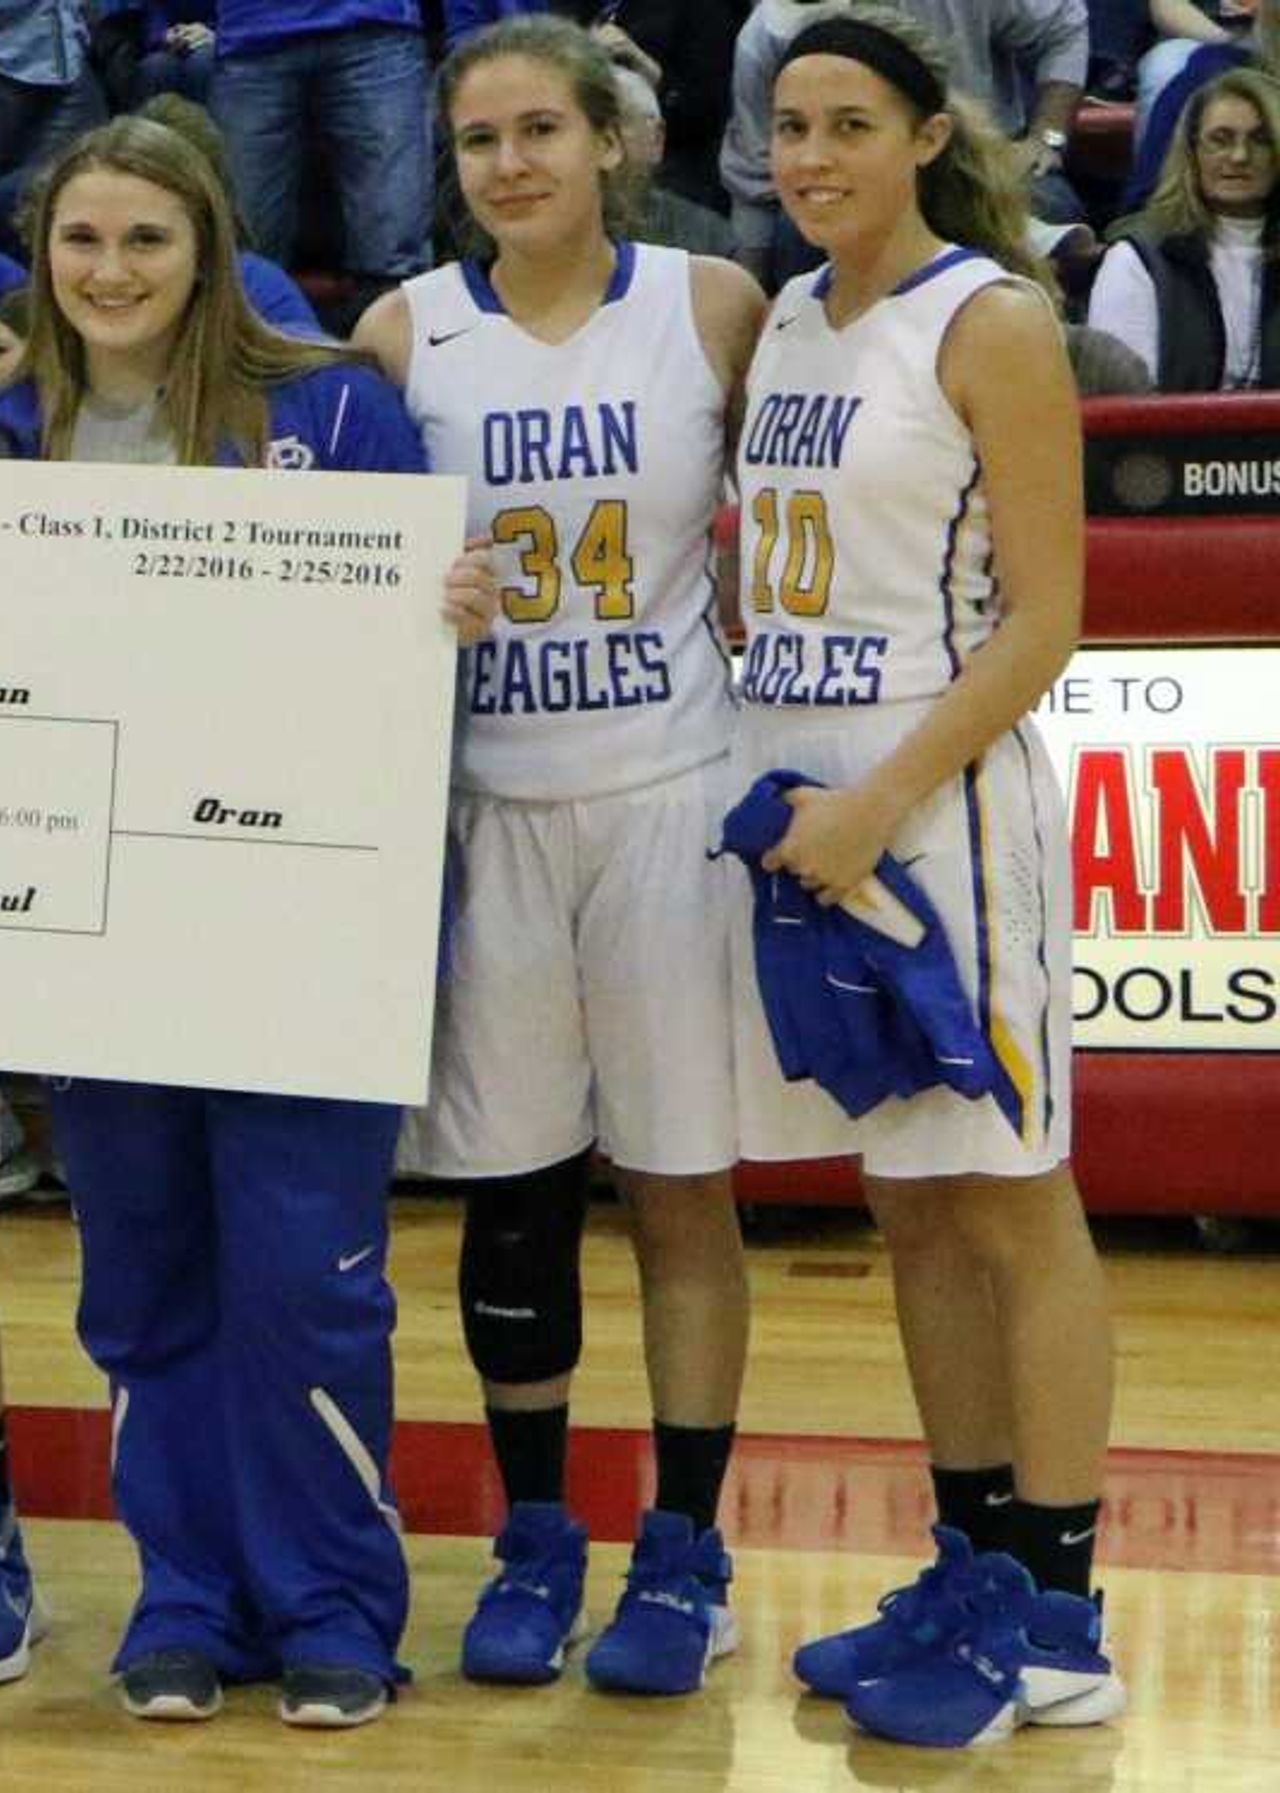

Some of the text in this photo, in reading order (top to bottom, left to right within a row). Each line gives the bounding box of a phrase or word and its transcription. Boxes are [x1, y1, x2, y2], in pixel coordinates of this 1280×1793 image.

[482, 401, 638, 486] ORAN
[745, 393, 862, 468] ORAN
[18, 512, 85, 537] Class
[93, 515, 113, 541] 1,
[121, 517, 214, 543] District
[222, 521, 237, 543] 2
[246, 522, 403, 550] Tournament
[752, 487, 834, 617] 10
[134, 554, 255, 581] 2/22/2016
[278, 559, 402, 587] 2/25/2016
[492, 499, 635, 622] 34
[470, 632, 671, 715] EAGLES
[1110, 677, 1184, 714] TO
[45, 811, 79, 834] pm
[193, 798, 283, 828] Oran
